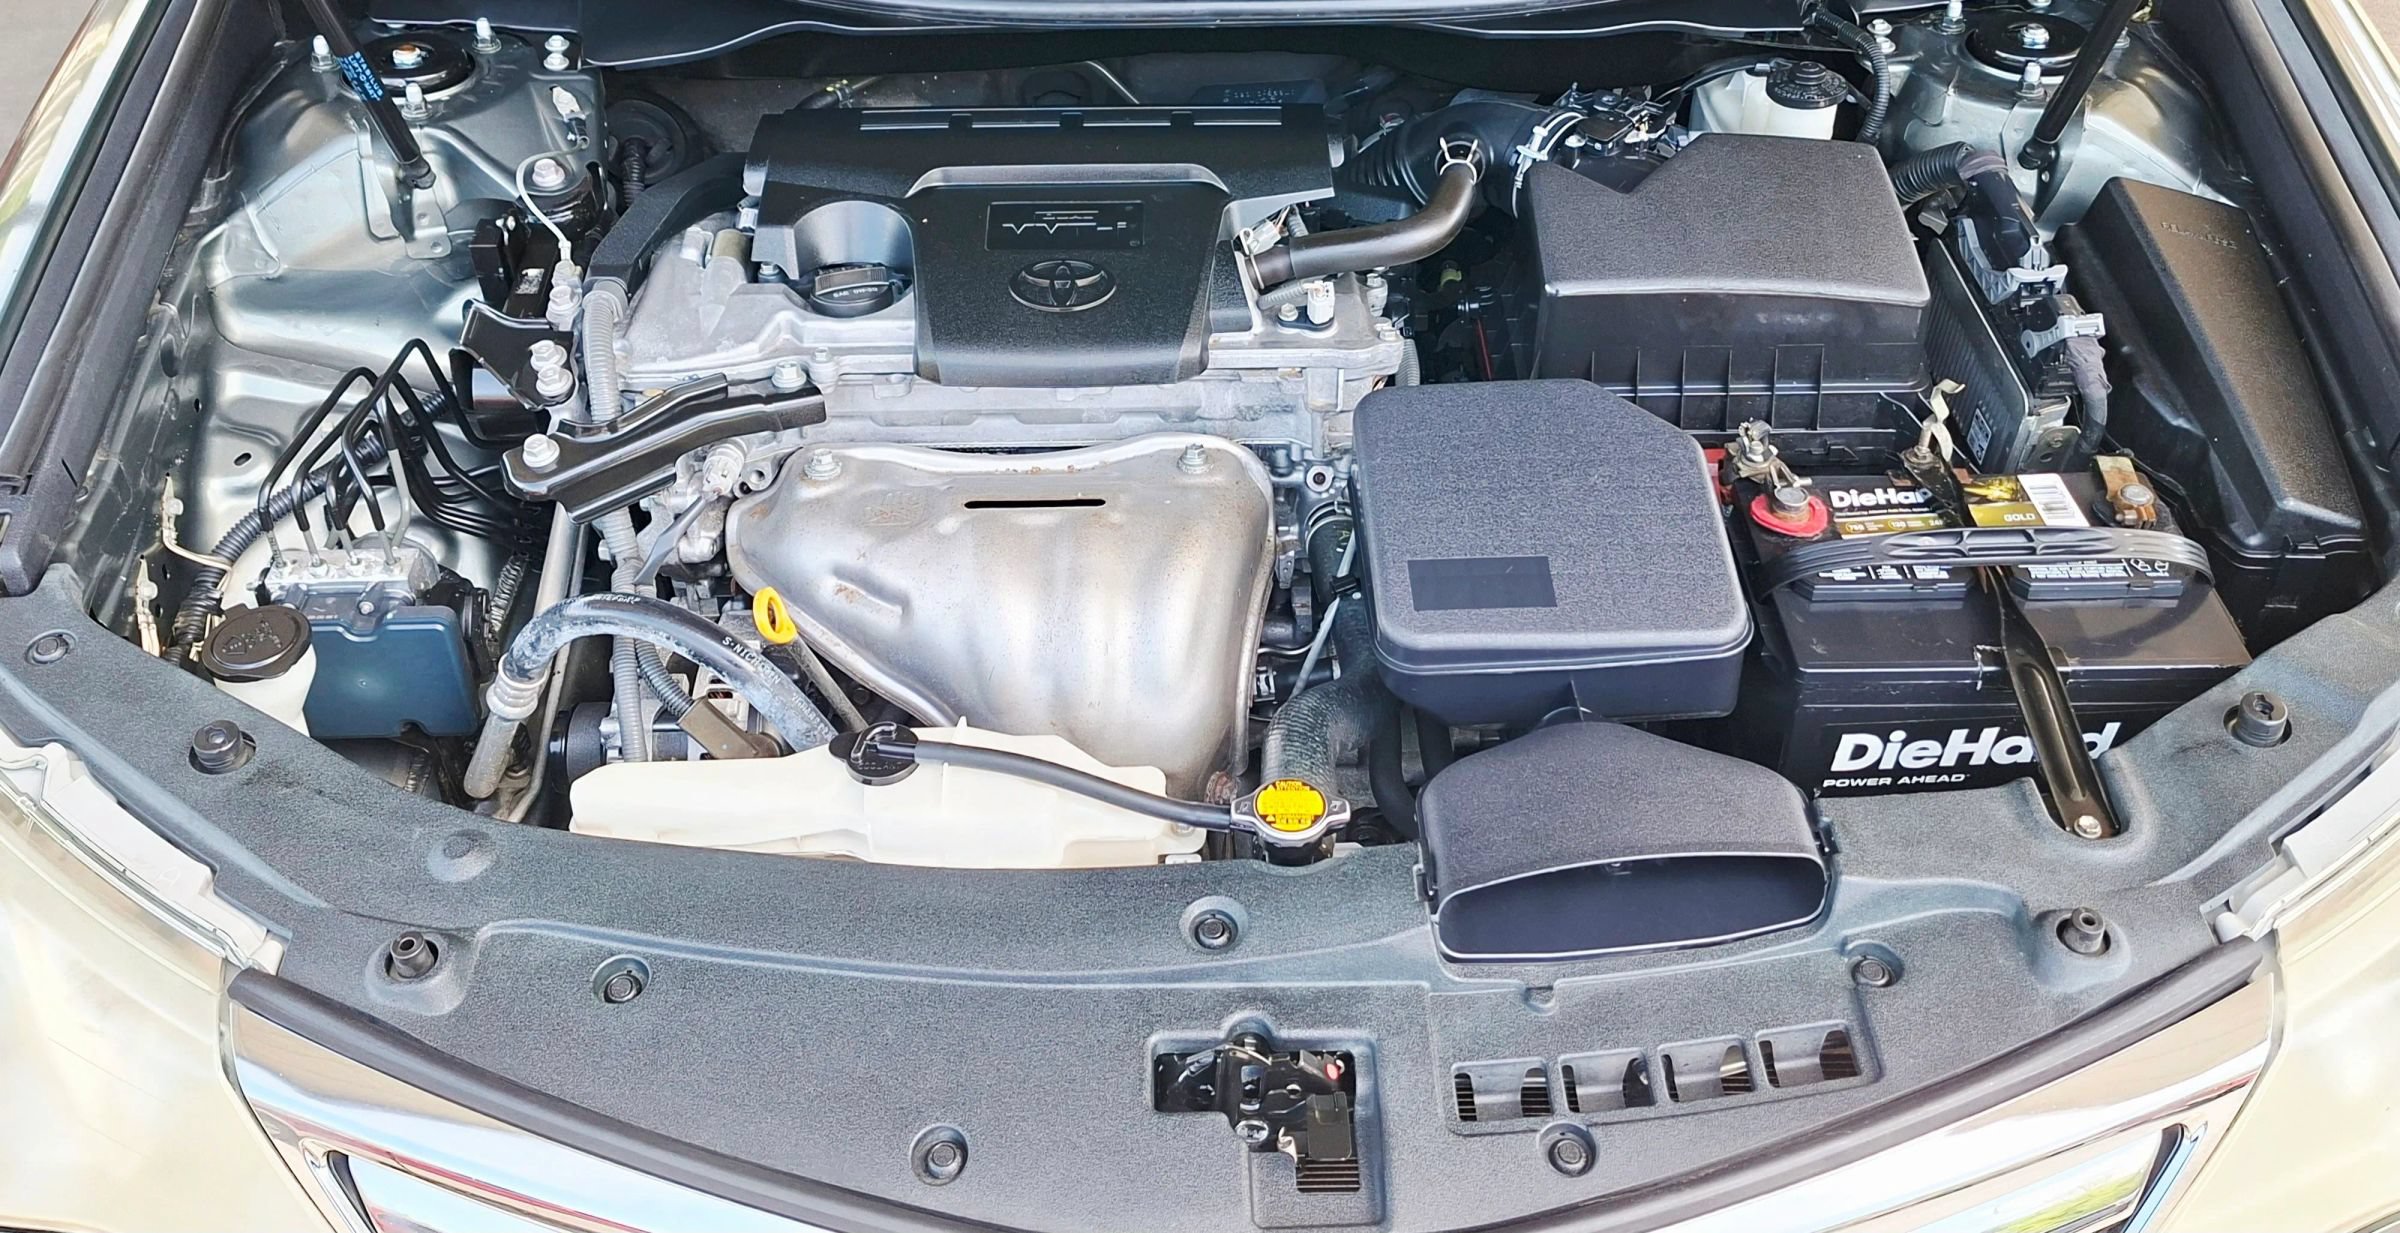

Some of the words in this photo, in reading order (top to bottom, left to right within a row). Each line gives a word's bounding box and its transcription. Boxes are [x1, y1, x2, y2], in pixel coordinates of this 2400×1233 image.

[354, 51, 383, 96] STABILUS
[833, 290, 850, 298] SAE
[2003, 513, 2036, 522] GOLD
[1830, 721, 2122, 772] DieHad
[1822, 777, 1892, 788] POWER
